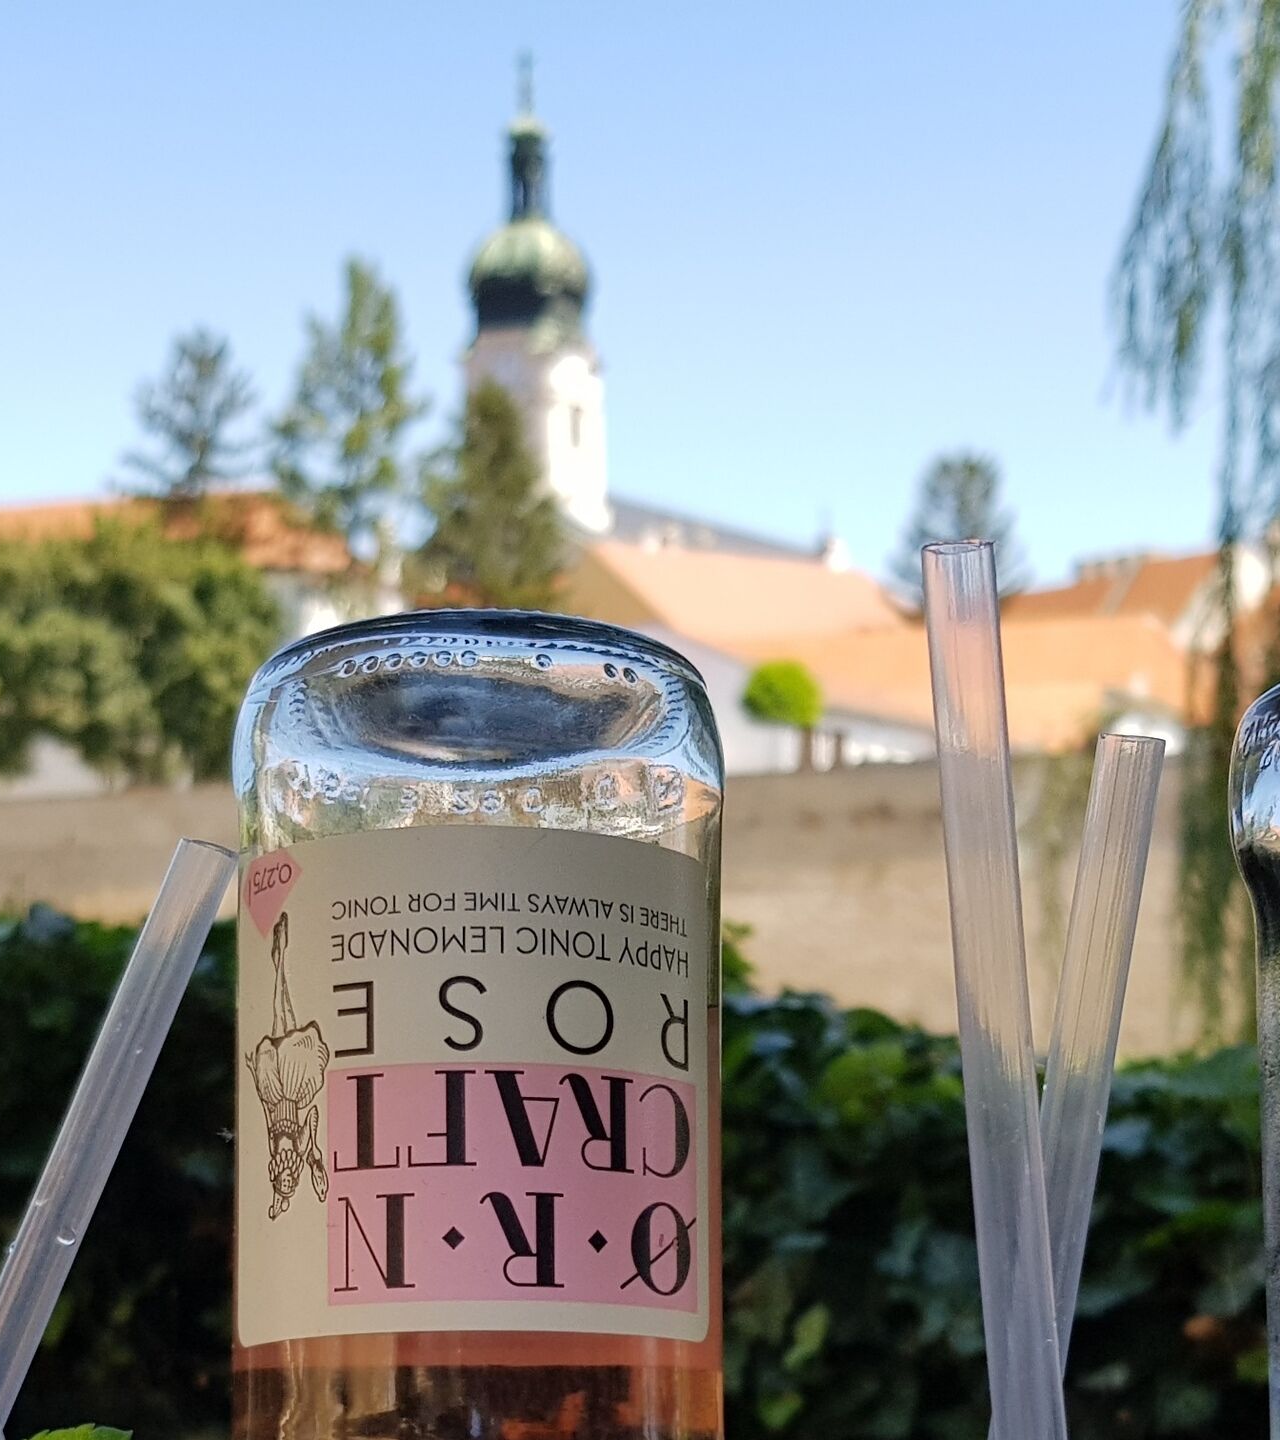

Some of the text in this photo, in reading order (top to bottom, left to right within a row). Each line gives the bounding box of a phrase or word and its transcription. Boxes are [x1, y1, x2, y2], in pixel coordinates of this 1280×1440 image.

[332, 892, 687, 937] THERE IS ALWAYS TIME FOR TONIC
[331, 926, 688, 978] HAPPY TONIC LEMONADE
[332, 976, 689, 1071] ROSE
[333, 1069, 690, 1179] CRAFT
